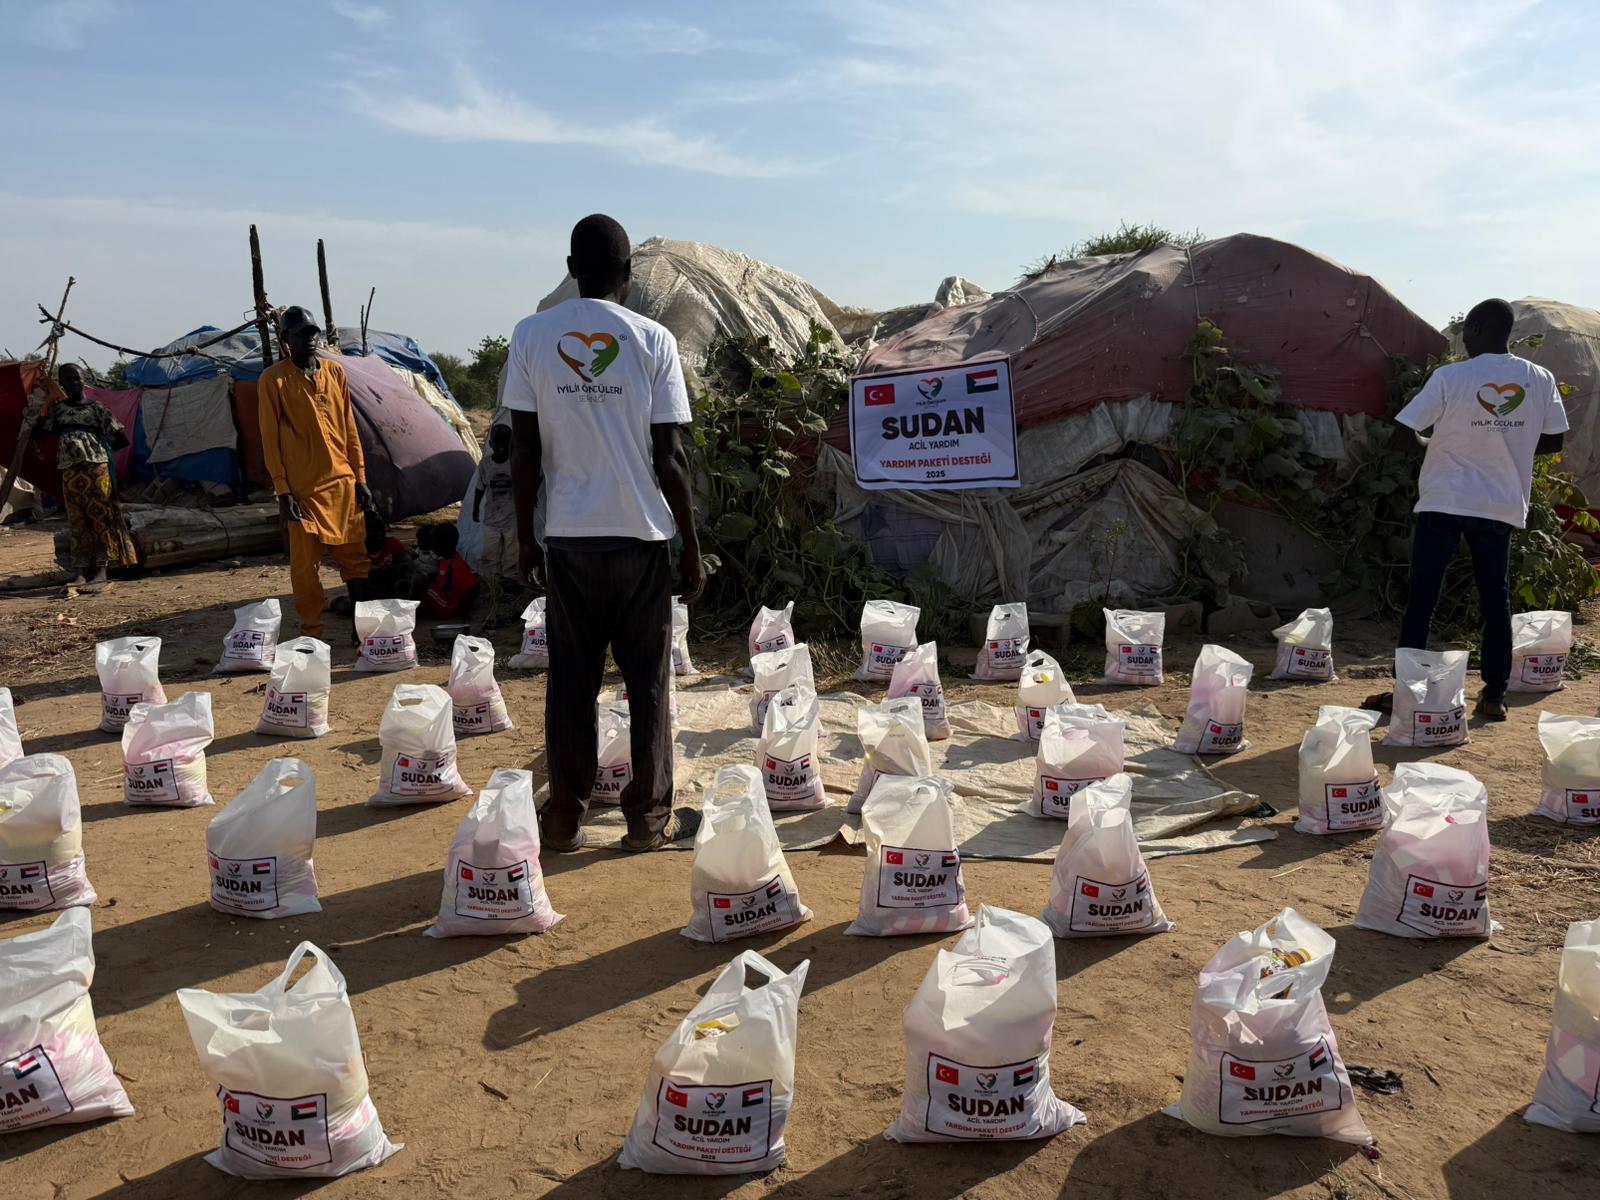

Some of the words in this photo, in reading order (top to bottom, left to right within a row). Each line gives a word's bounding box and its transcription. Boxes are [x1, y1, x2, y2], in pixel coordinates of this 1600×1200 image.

[881, 407, 985, 440] SUDAN
[909, 441, 927, 450] ACİL
[929, 440, 959, 449] YARDIM
[880, 459, 916, 469] YARDIM
[918, 455, 950, 468] PAKETİ
[951, 452, 992, 466] DESTEĞİ
[926, 470, 945, 479] 2025
[369, 647, 399, 656] SUDAN
[1127, 656, 1153, 665] SUDAN
[1298, 659, 1326, 668] SUDAN
[268, 702, 297, 715] SUDAN
[453, 715, 482, 724] UDAN
[1425, 723, 1460, 735] SUDAN
[594, 782, 620, 791] DAN
[769, 774, 807, 787] SUDAN
[1341, 796, 1381, 814] SUDAN
[216, 875, 262, 893] SUDAN
[893, 871, 948, 888] SUDAN
[0, 884, 34, 896] DAN
[467, 886, 519, 902] SUDAN
[724, 901, 777, 926] SUDAN
[1087, 899, 1143, 917] SUDAN
[1419, 903, 1480, 921] SUDAN
[0, 1083, 40, 1110] DAN
[1242, 1077, 1322, 1102] SUDAN
[947, 1093, 1025, 1117] SUDAN
[234, 1120, 306, 1147] SUDAN
[674, 1114, 752, 1137] SUDAN
